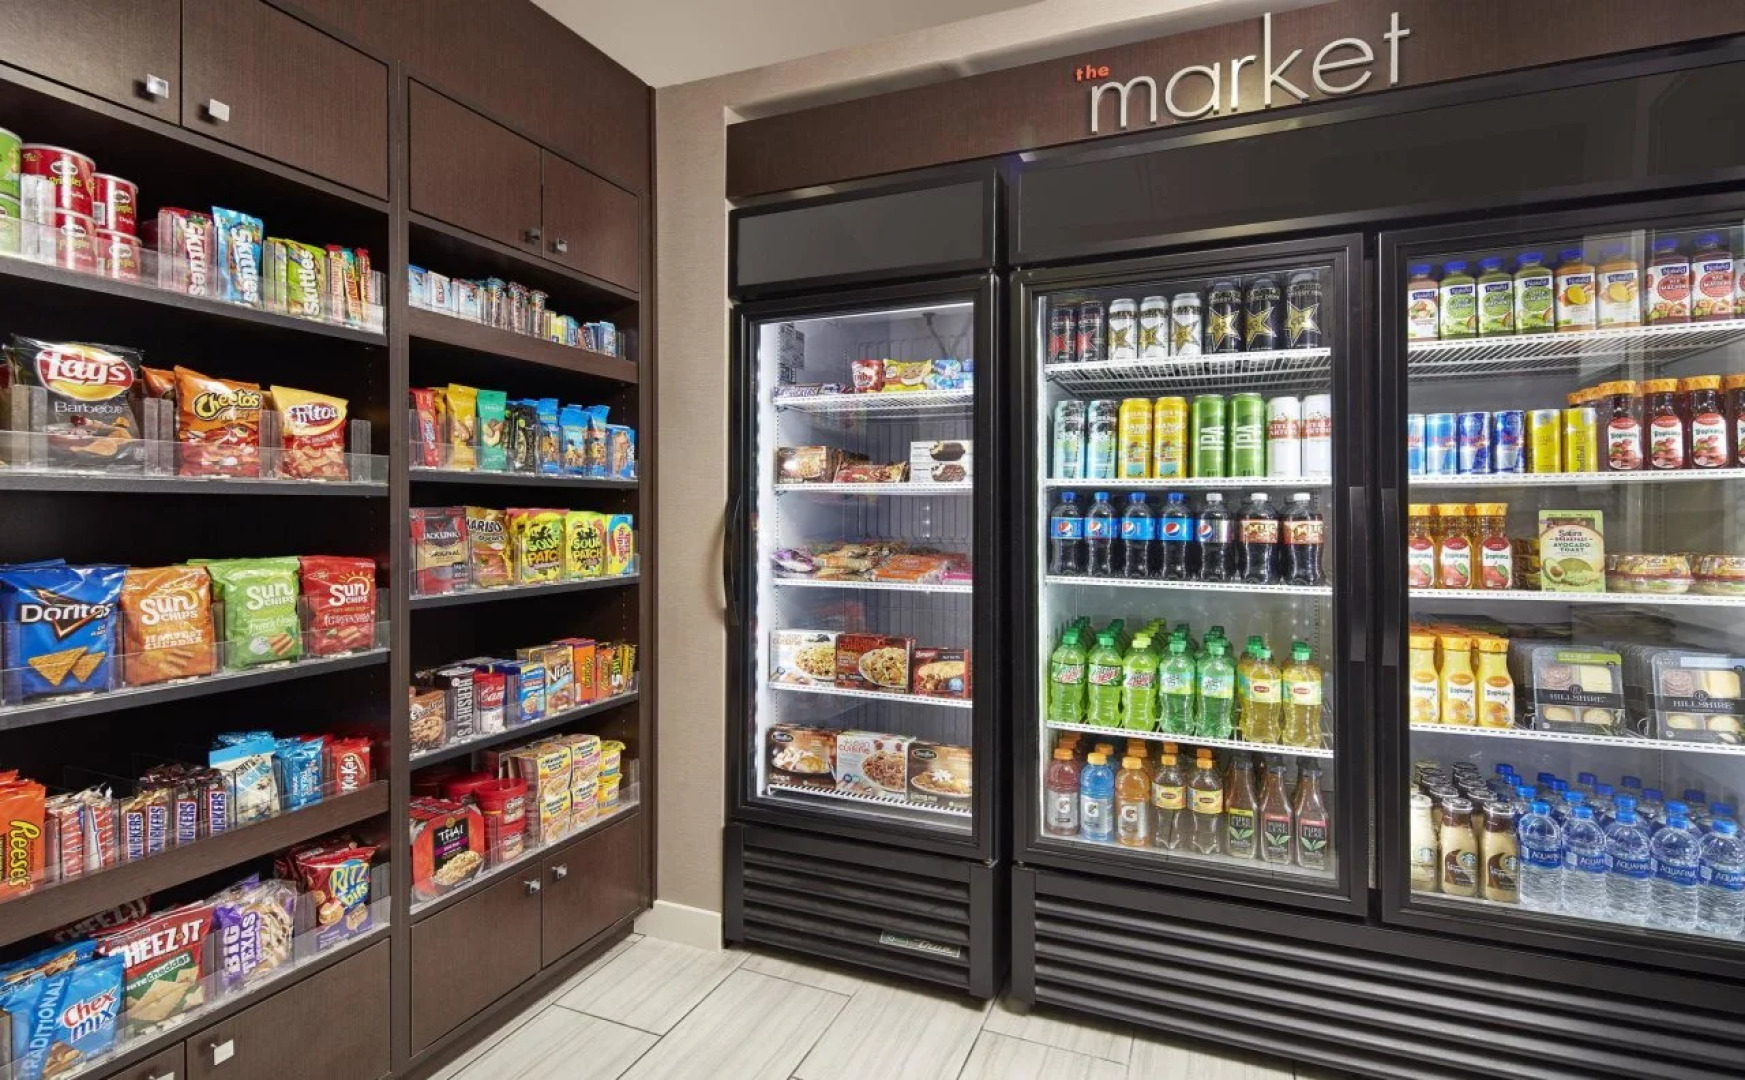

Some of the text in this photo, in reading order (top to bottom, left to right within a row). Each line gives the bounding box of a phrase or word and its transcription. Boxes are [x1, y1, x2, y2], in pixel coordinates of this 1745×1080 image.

[1076, 64, 1111, 82] the
[1091, 12, 1411, 135] market
[48, 350, 128, 386] Lay's
[55, 401, 123, 414] Barbecue
[194, 388, 261, 420] Cheetos
[20, 602, 114, 623] Doritos
[139, 593, 198, 626] Sun
[246, 583, 294, 611] Sun
[328, 584, 369, 606] Sun
[159, 610, 199, 622] CHIPS
[458, 678, 473, 737] HERSHEY'S
[1673, 700, 1731, 710] HILLSHIRE
[180, 803, 196, 841] ICKERS
[211, 792, 226, 830] ICKERS
[129, 814, 142, 860] NICKERS
[150, 807, 165, 852] NICKERS
[10, 820, 41, 886] Reese's
[330, 862, 370, 899] RITZ
[223, 925, 241, 972] BIG
[240, 913, 257, 975] TEXAS
[62, 984, 118, 1029] Chex
[70, 1009, 116, 1043] mix
